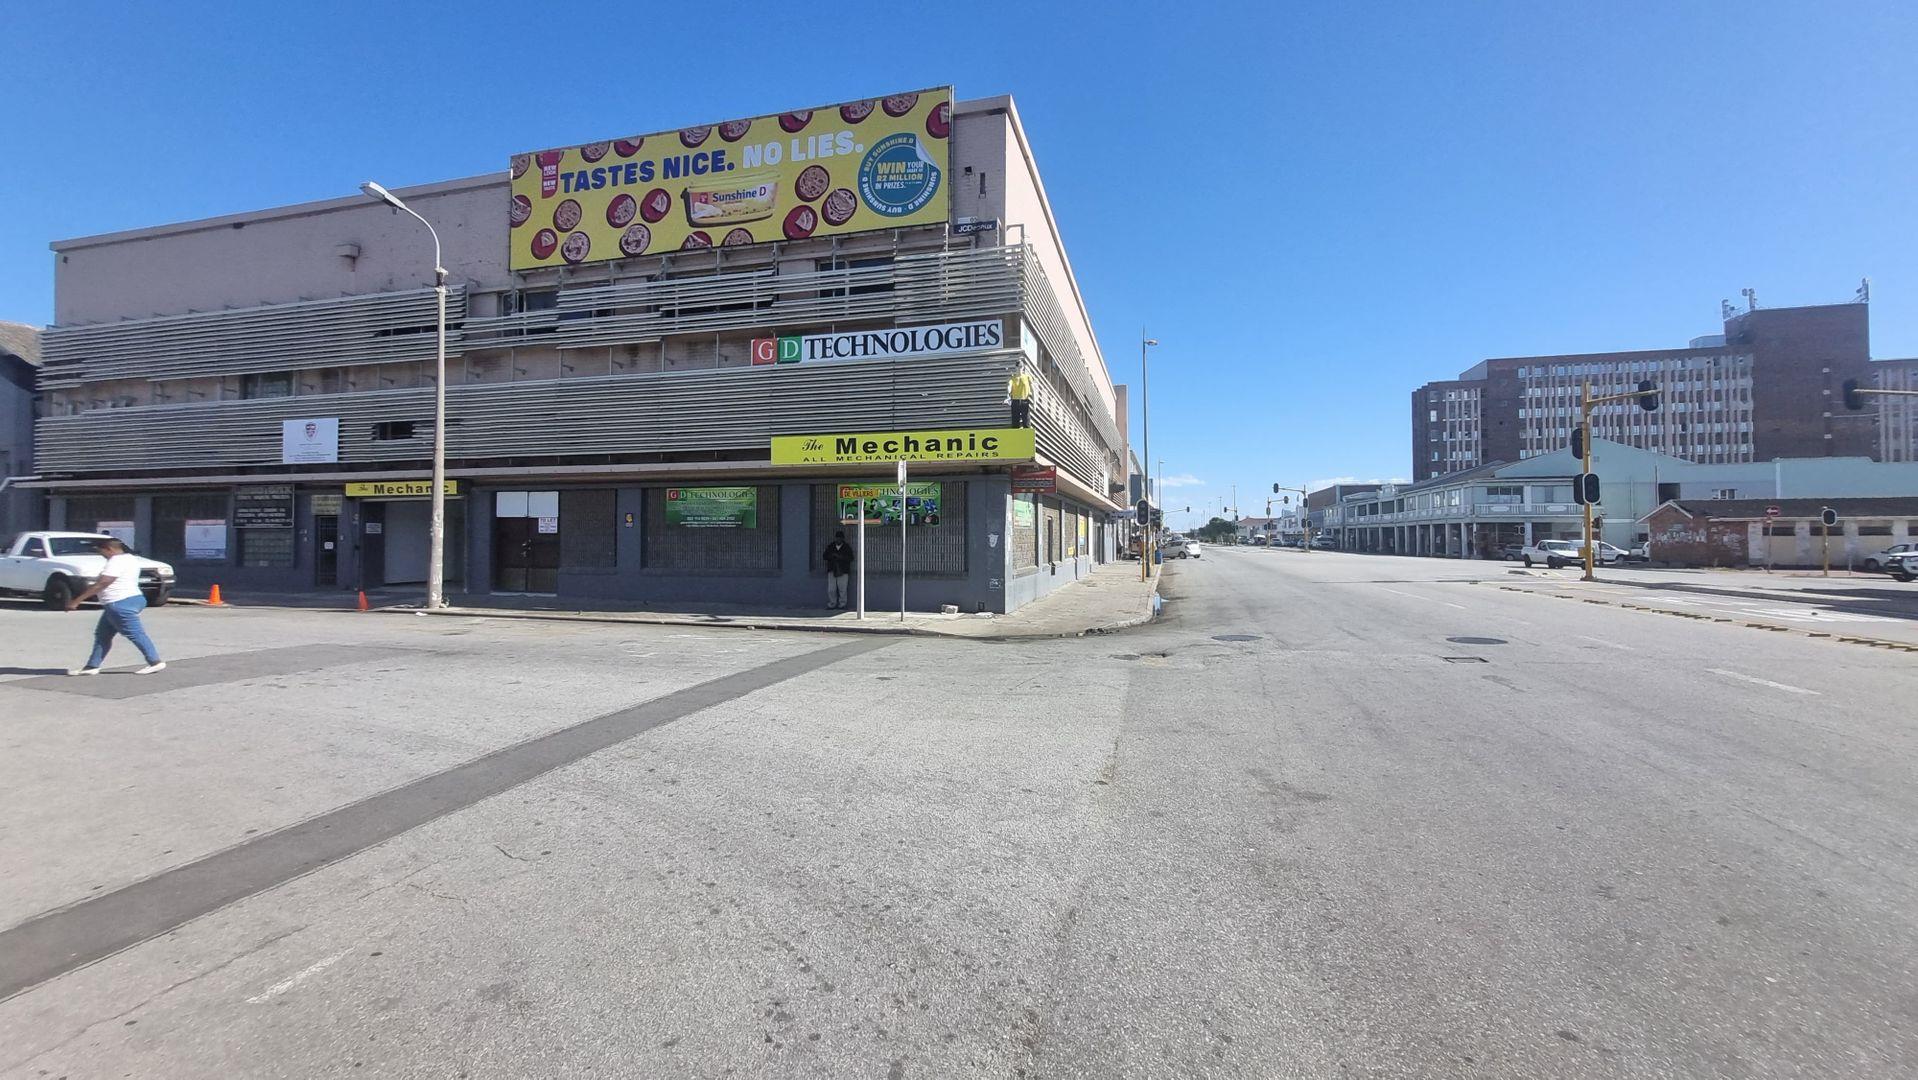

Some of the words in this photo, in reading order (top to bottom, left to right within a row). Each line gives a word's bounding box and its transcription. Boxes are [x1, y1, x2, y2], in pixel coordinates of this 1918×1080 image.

[872, 137, 908, 157] SUNSHINE
[560, 160, 655, 193] TASTES
[663, 150, 735, 180] NICE.
[743, 141, 783, 168] NO
[790, 130, 864, 161] LIES.
[877, 161, 906, 174] WIN
[907, 160, 924, 169] YOUR
[876, 174, 887, 182] R2
[888, 173, 923, 181] MILLION
[712, 189, 757, 202] Sunshine
[759, 186, 767, 197] D
[862, 183, 887, 211] SUNSHINE
[915, 171, 938, 206] SUNSHINE
[804, 322, 1000, 360] TECHNOLOGIES
[801, 439, 824, 452] The
[836, 433, 999, 455] Mechanic
[836, 453, 926, 462] MECHANICAL
[374, 483, 449, 494] Mechanc
